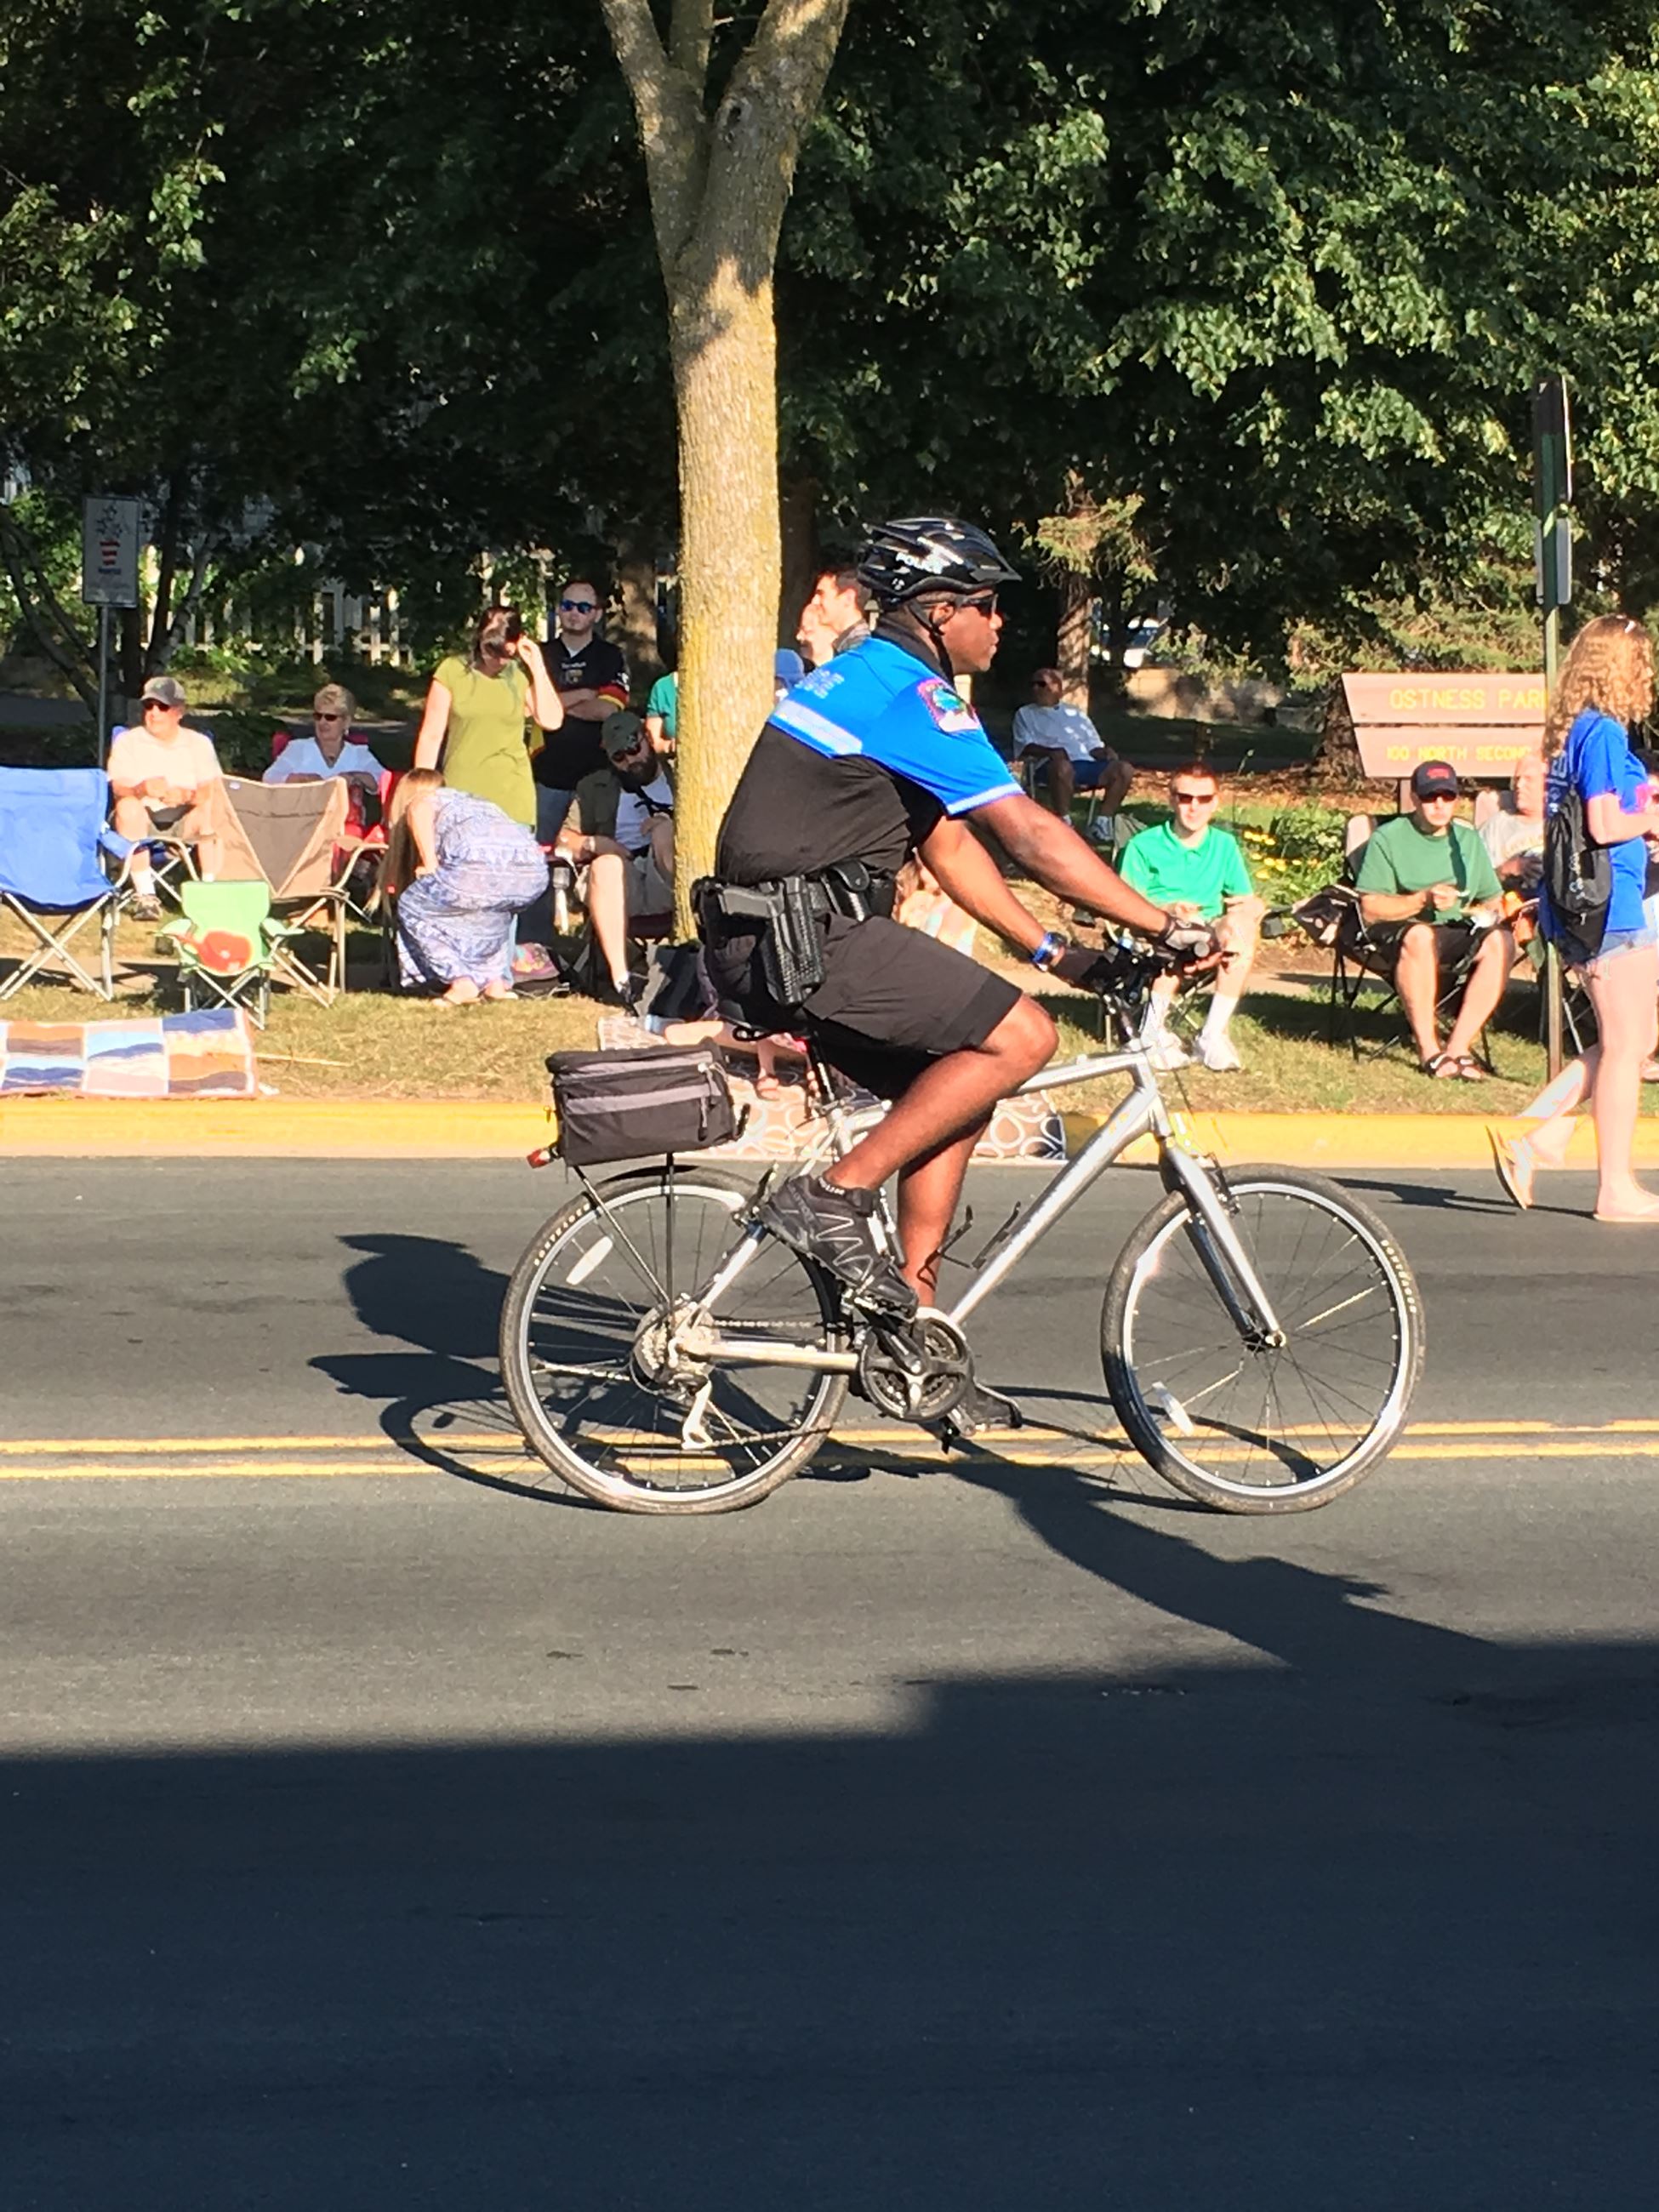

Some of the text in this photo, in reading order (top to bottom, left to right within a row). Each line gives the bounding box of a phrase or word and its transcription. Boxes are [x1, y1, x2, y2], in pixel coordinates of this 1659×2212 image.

[1389, 688, 1485, 710] OSTNESS
[1386, 745, 1410, 761] 100
[1418, 745, 1468, 761] NORTH
